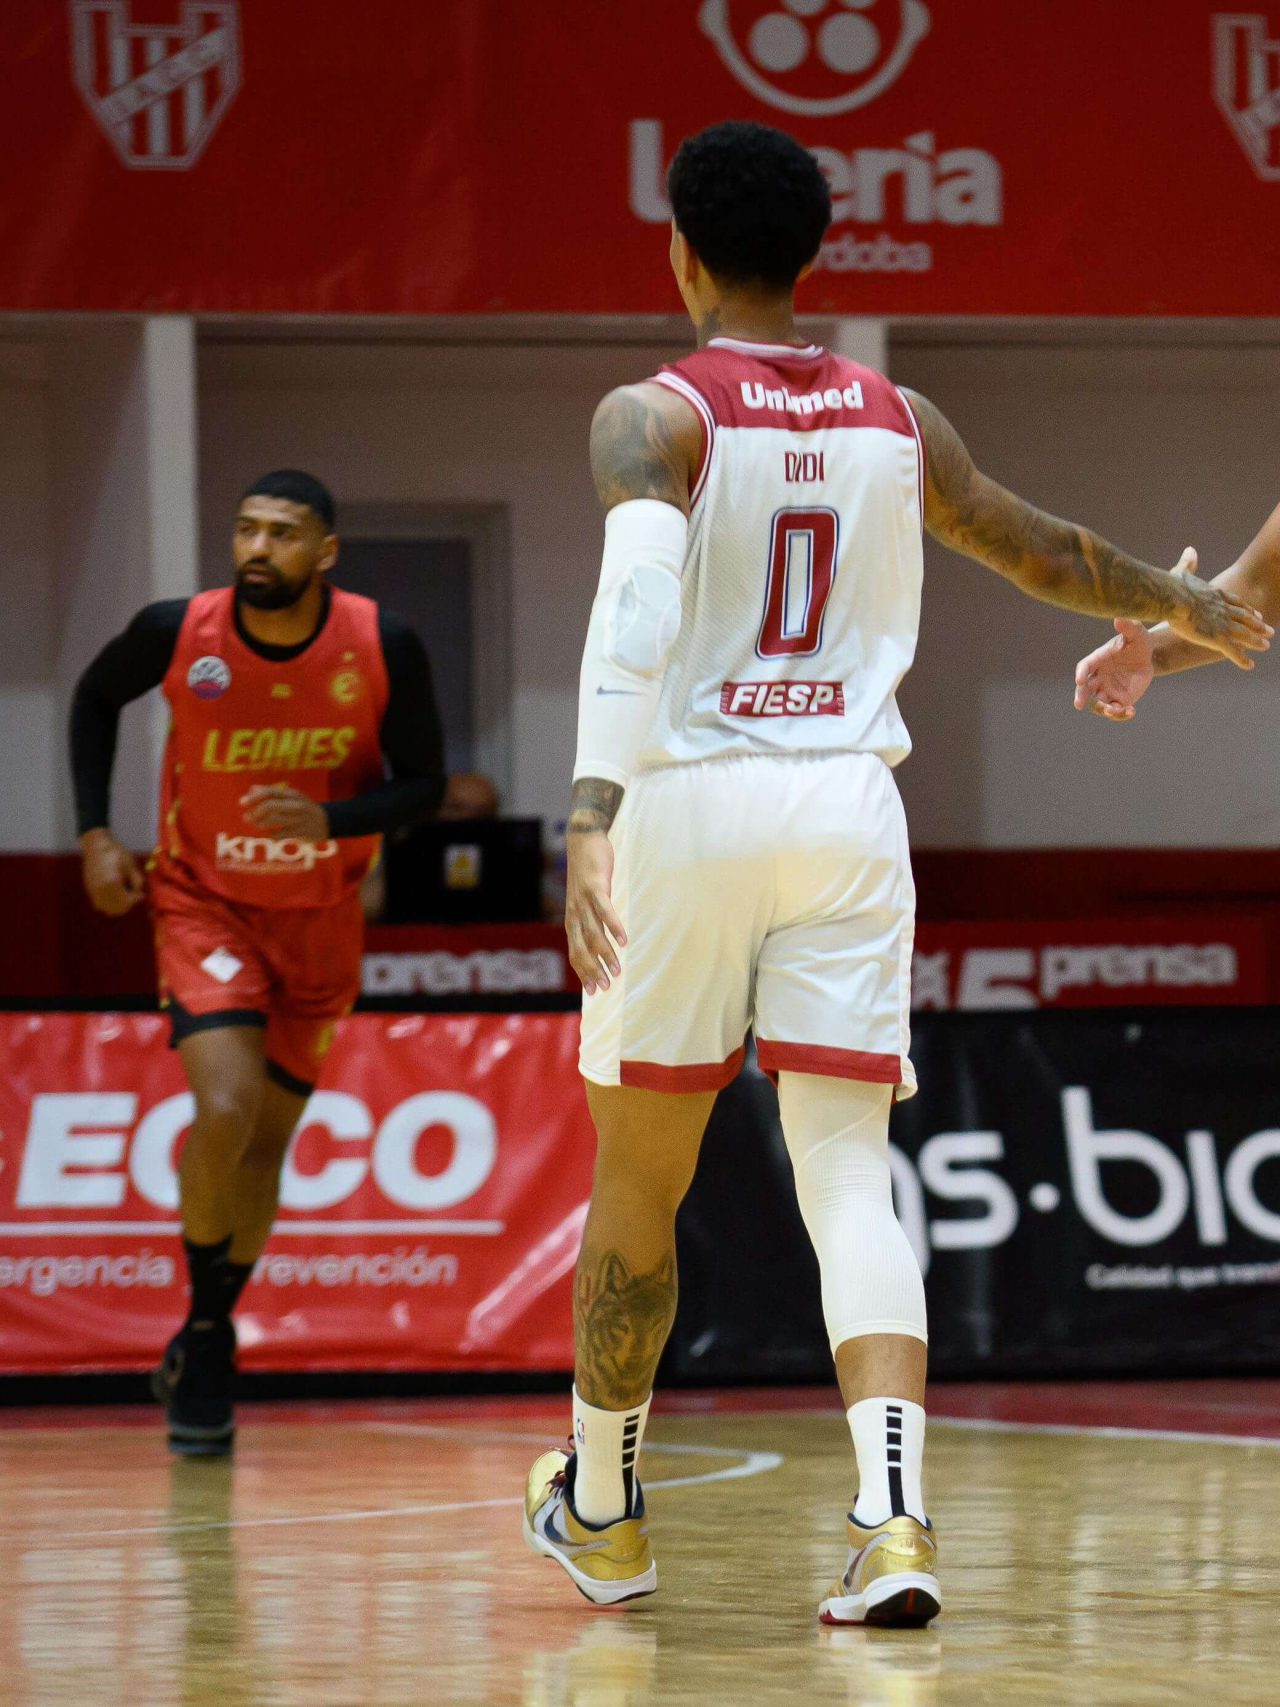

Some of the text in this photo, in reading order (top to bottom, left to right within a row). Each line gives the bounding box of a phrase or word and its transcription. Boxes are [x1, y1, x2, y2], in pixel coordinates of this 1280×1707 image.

[740, 380, 864, 415] Unimed
[755, 505, 840, 661] 0
[729, 684, 834, 714] FIESP
[202, 726, 356, 773] LEONES
[1041, 944, 1237, 998] prensa
[252, 1246, 459, 1287] revención
